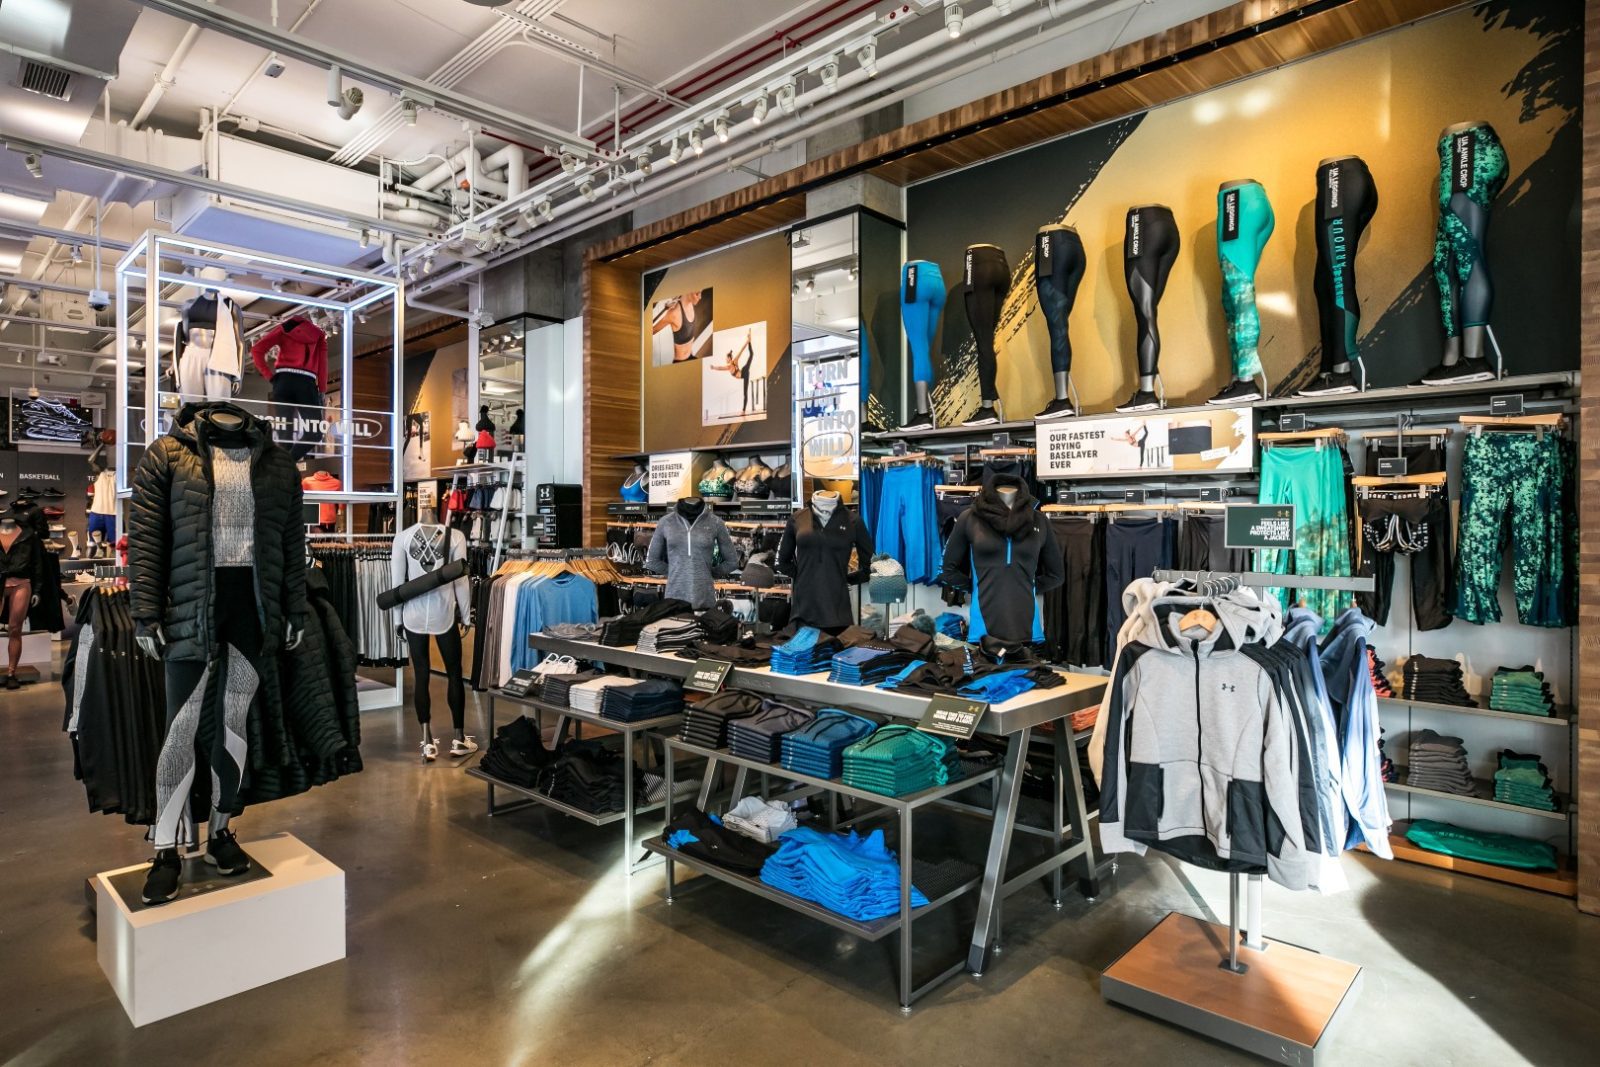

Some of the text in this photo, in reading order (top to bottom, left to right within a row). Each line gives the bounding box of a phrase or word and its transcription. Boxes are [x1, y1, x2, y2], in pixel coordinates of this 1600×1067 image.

[1460, 135, 1469, 188] UA ANKLE CROP
[1332, 218, 1346, 267] ARMOUR
[806, 362, 848, 384] TURN
[293, 418, 330, 434] INTO
[336, 421, 372, 437] WILL
[818, 409, 856, 432] INTO
[1050, 430, 1105, 442] OUR FASTEST
[1050, 441, 1082, 451] DRYING
[808, 436, 844, 457] WILL
[1050, 450, 1098, 460] BASELAYER
[1050, 460, 1072, 469] EVER
